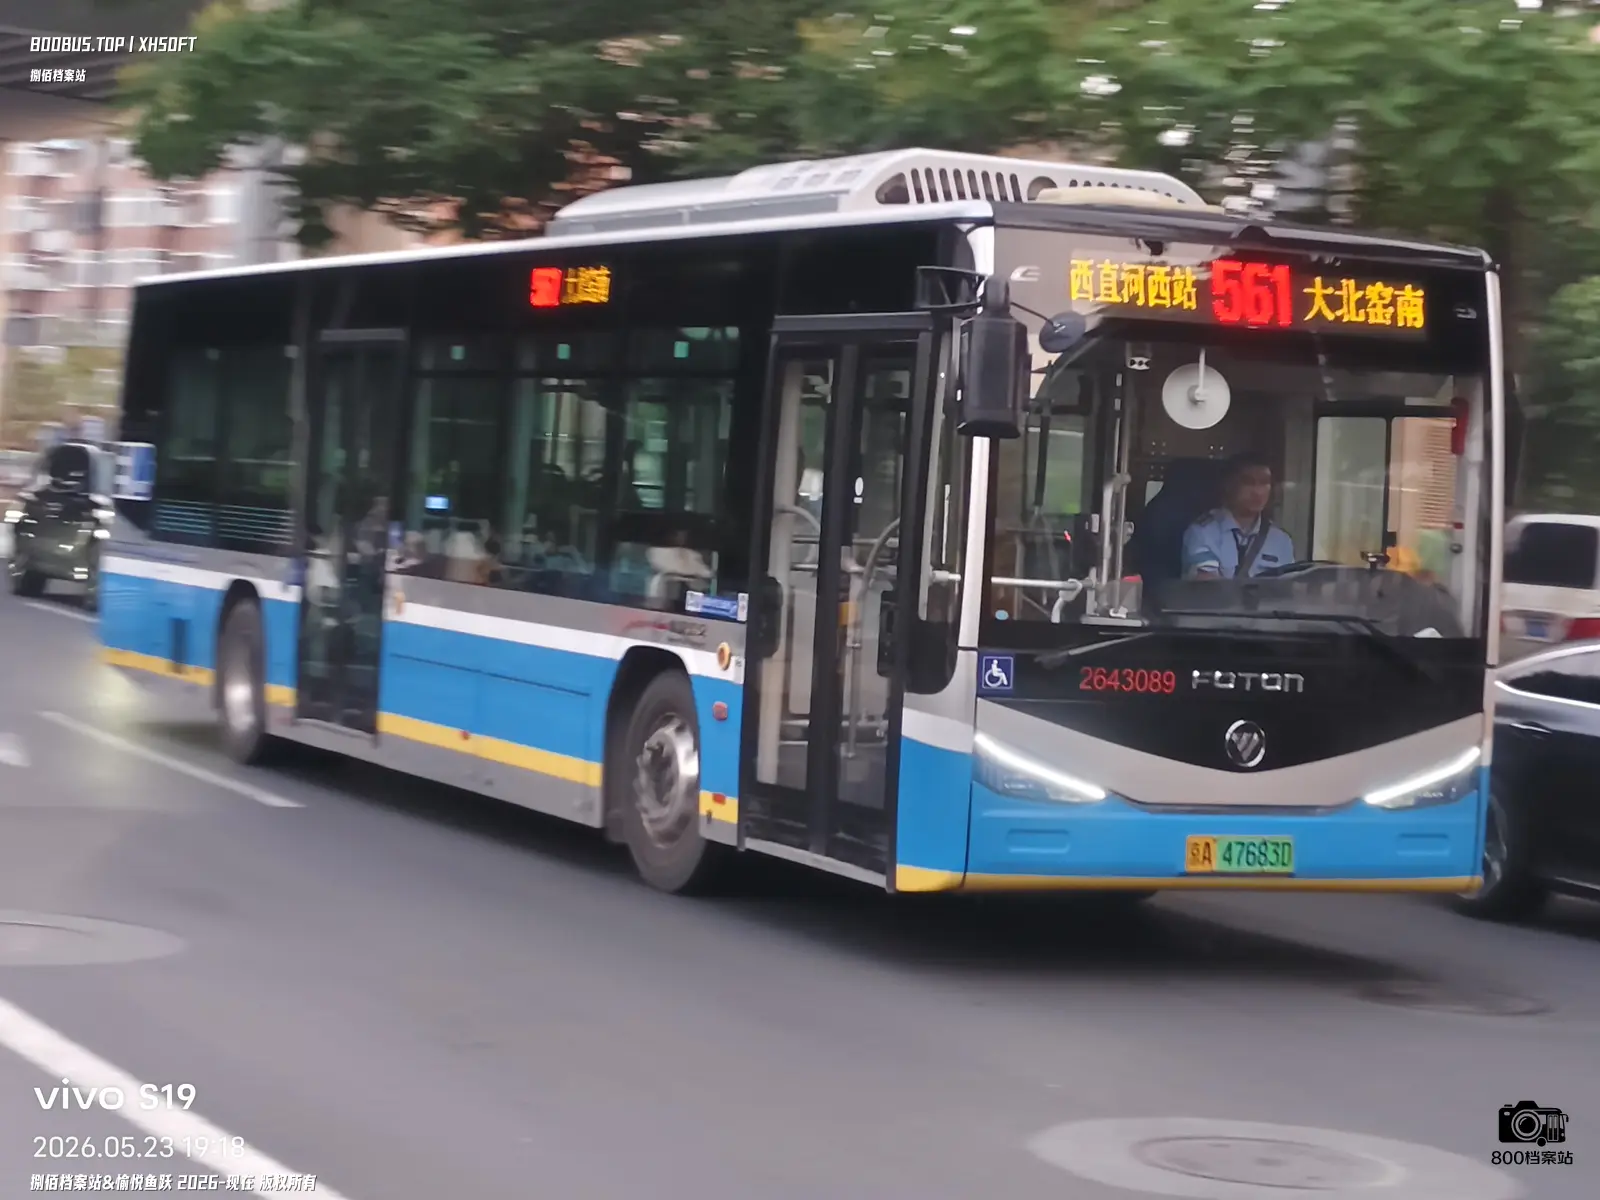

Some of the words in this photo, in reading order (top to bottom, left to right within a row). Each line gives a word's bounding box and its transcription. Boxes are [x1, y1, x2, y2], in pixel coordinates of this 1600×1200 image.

[1069, 257, 1198, 310] 西直河西站
[1211, 259, 1293, 327] 561
[1302, 276, 1426, 329] 大北窑南
[1079, 666, 1176, 694] 2643089
[1191, 669, 1306, 693] FOTON
